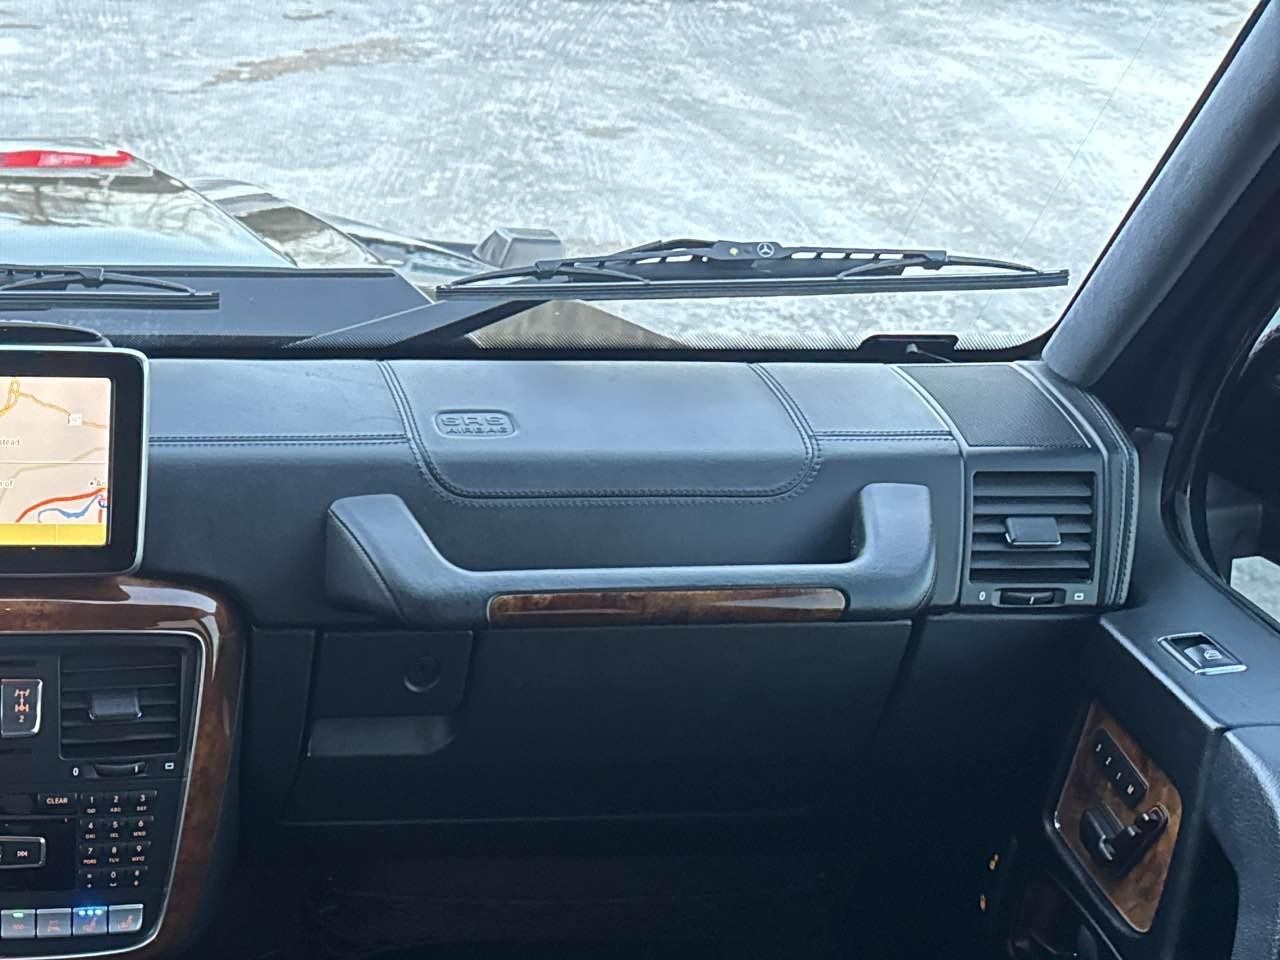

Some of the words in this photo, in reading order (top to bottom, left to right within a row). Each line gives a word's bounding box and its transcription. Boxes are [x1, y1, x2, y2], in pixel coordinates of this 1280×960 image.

[441, 416, 505, 426] SRS
[446, 426, 508, 434] AIRBAG
[18, 715, 24, 723] 2
[46, 797, 68, 805] CLEAR
[90, 796, 94, 804] 1
[114, 795, 119, 803] 2
[140, 794, 146, 802] 3
[112, 821, 118, 829] 5
[88, 847, 93, 855] 7
